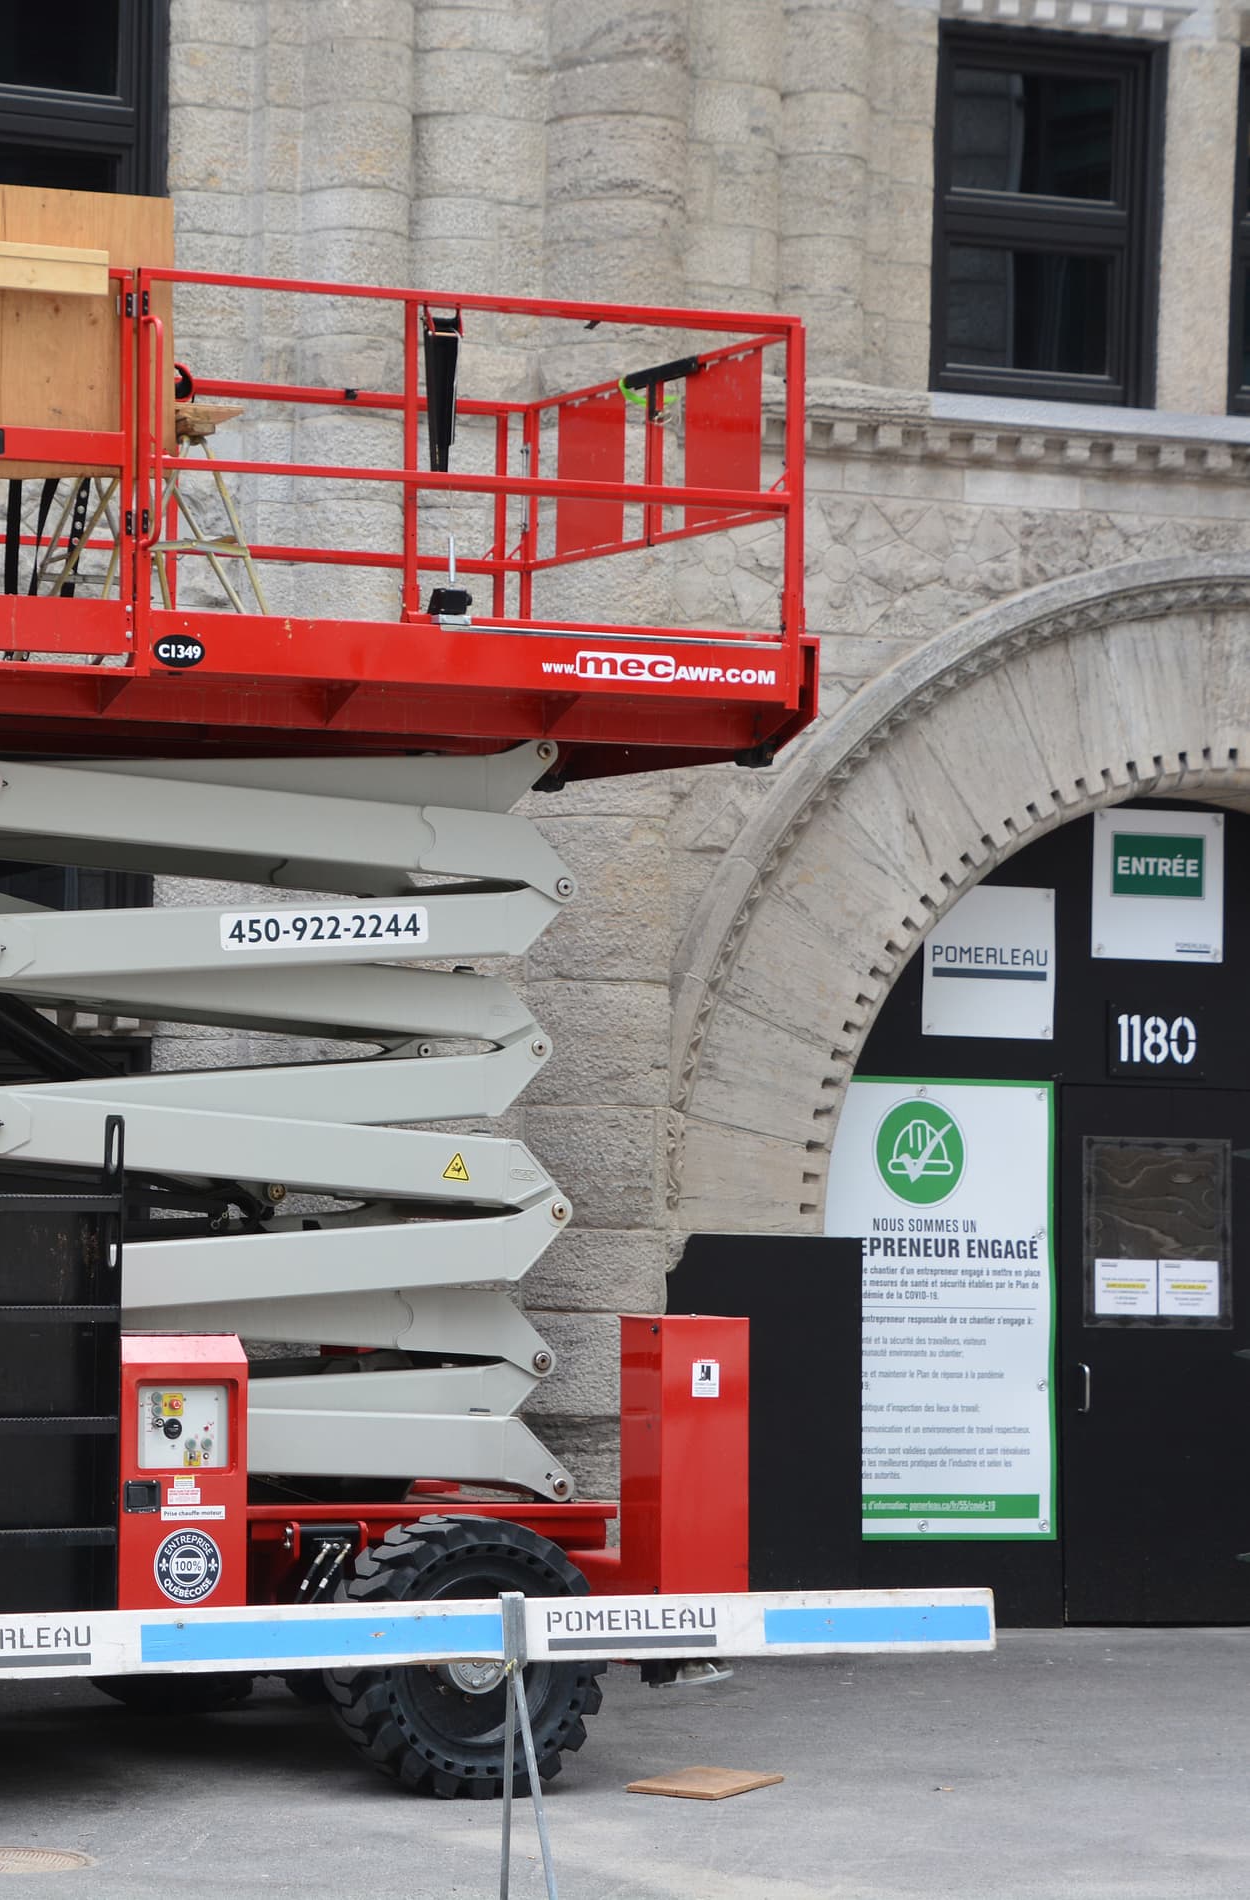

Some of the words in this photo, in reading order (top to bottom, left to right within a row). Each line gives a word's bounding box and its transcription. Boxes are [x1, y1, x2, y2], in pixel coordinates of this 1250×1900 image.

[1117, 854, 1199, 878] ENTRÉE
[228, 912, 421, 944] 450-922-2244
[932, 945, 1048, 967] POMERLEAU
[1117, 1014, 1197, 1064] 1180
[873, 1218, 904, 1232] NOUS
[908, 1219, 959, 1232] SOMMES
[963, 1219, 977, 1233] UN
[966, 1235, 1038, 1259] ENGAGÉ
[870, 1266, 898, 1275] chantier
[917, 1267, 958, 1277] entrepreneur
[908, 1315, 947, 1325] responsable
[164, 1534, 214, 1556] ENTREPRISE
[175, 1560, 202, 1572] 100%
[163, 1577, 213, 1598] QUÉBÉCOISE
[546, 1607, 717, 1633] POMERLEAU
